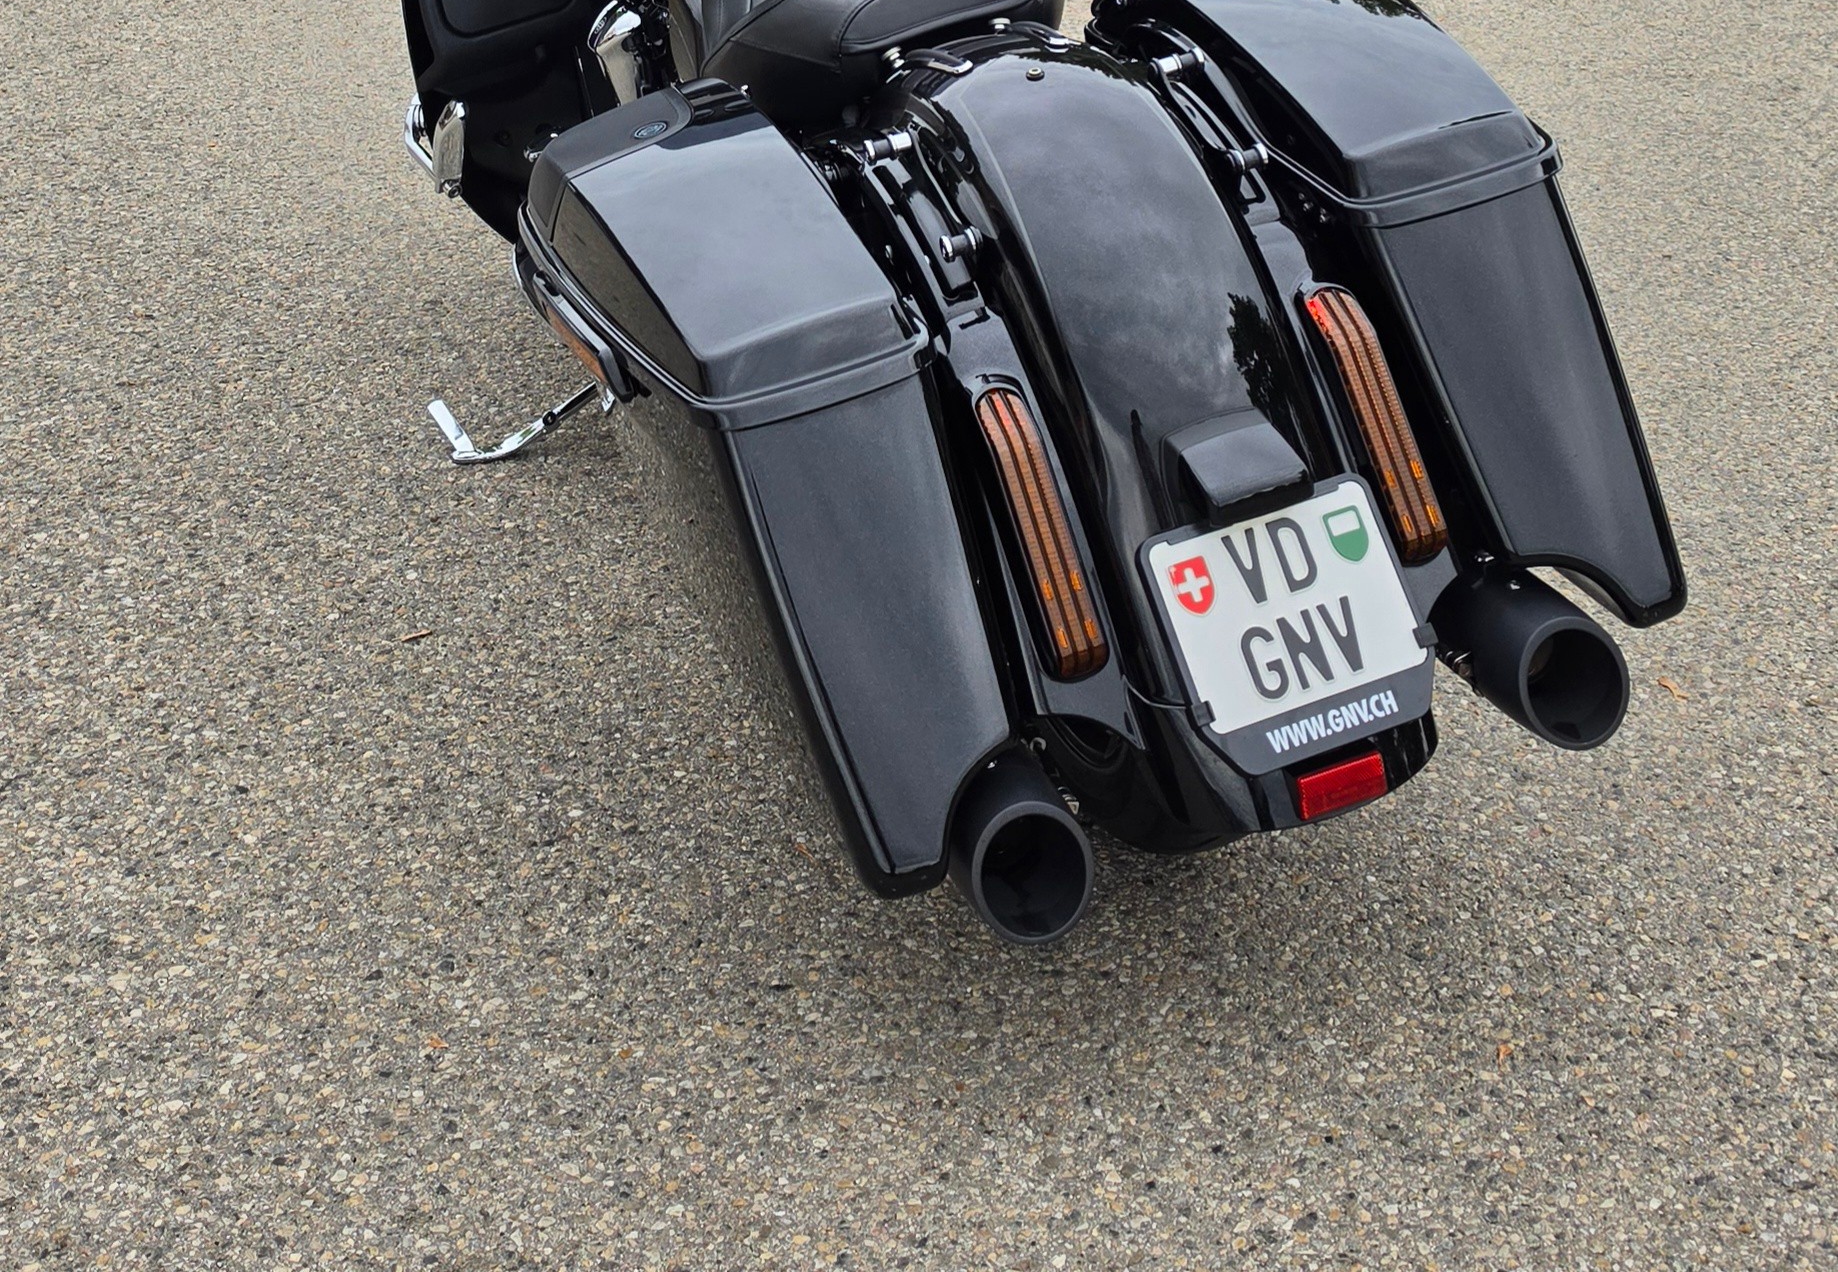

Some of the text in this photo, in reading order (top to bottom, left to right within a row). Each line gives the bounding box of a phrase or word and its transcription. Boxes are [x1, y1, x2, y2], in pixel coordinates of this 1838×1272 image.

[1221, 517, 1318, 604] VD
[1240, 595, 1364, 700] GNV
[1266, 690, 1399, 754] WWW.GNV.CH
